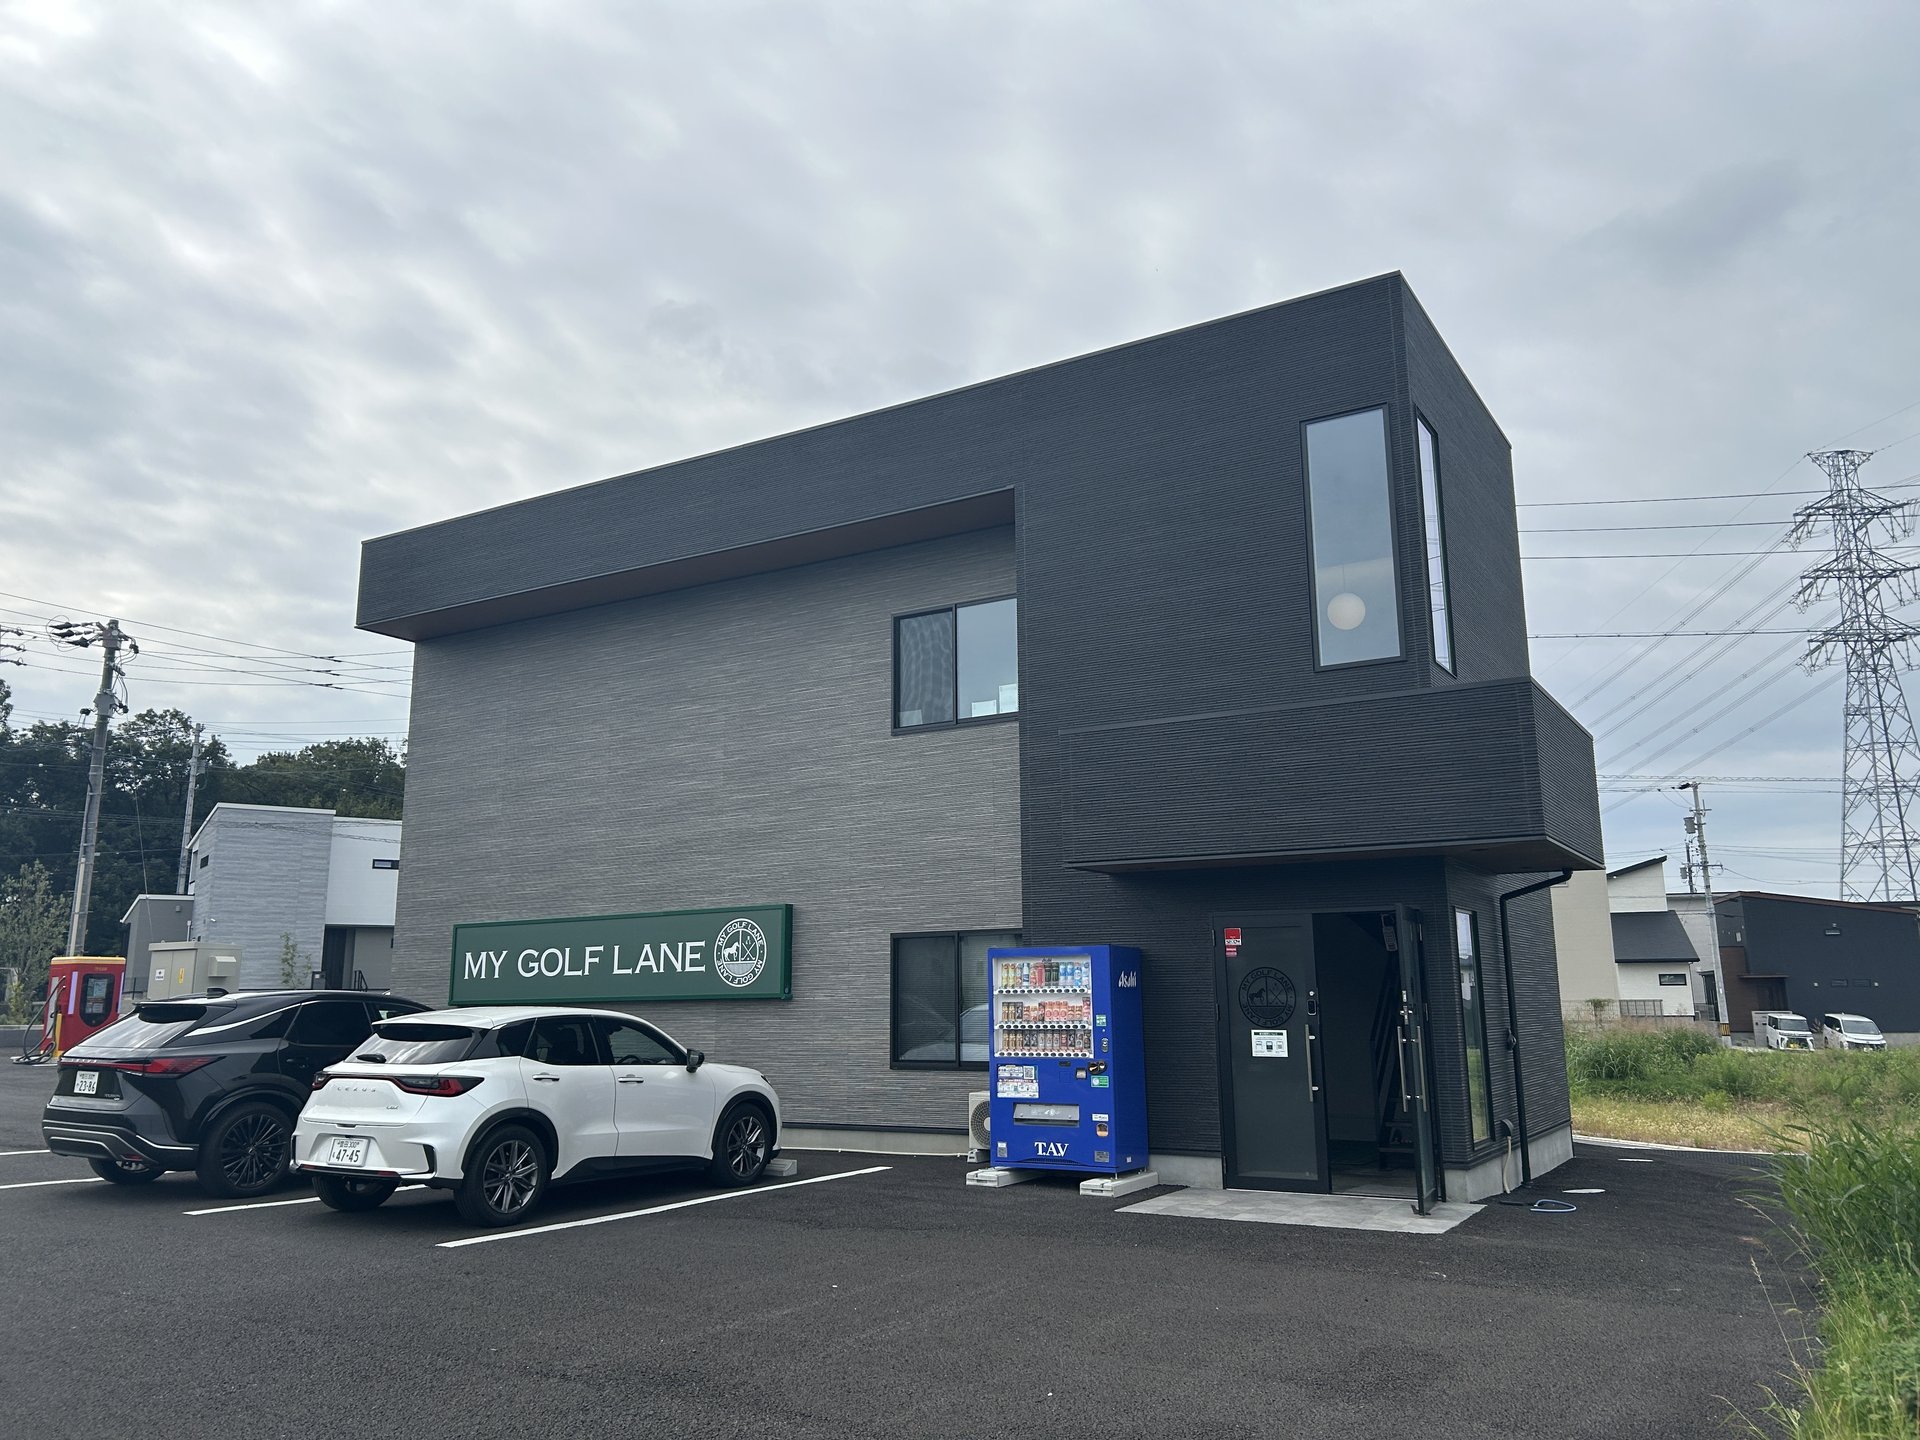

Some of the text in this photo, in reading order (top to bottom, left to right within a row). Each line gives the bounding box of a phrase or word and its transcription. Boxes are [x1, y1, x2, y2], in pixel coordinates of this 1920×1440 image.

[718, 922, 763, 947] MY GOLF LANE
[463, 940, 706, 979] MY GOLF LANE
[717, 958, 733, 981] LANE
[733, 973, 753, 984] GOLF
[1118, 970, 1136, 988] Asahi
[336, 1149, 361, 1163] 47-45
